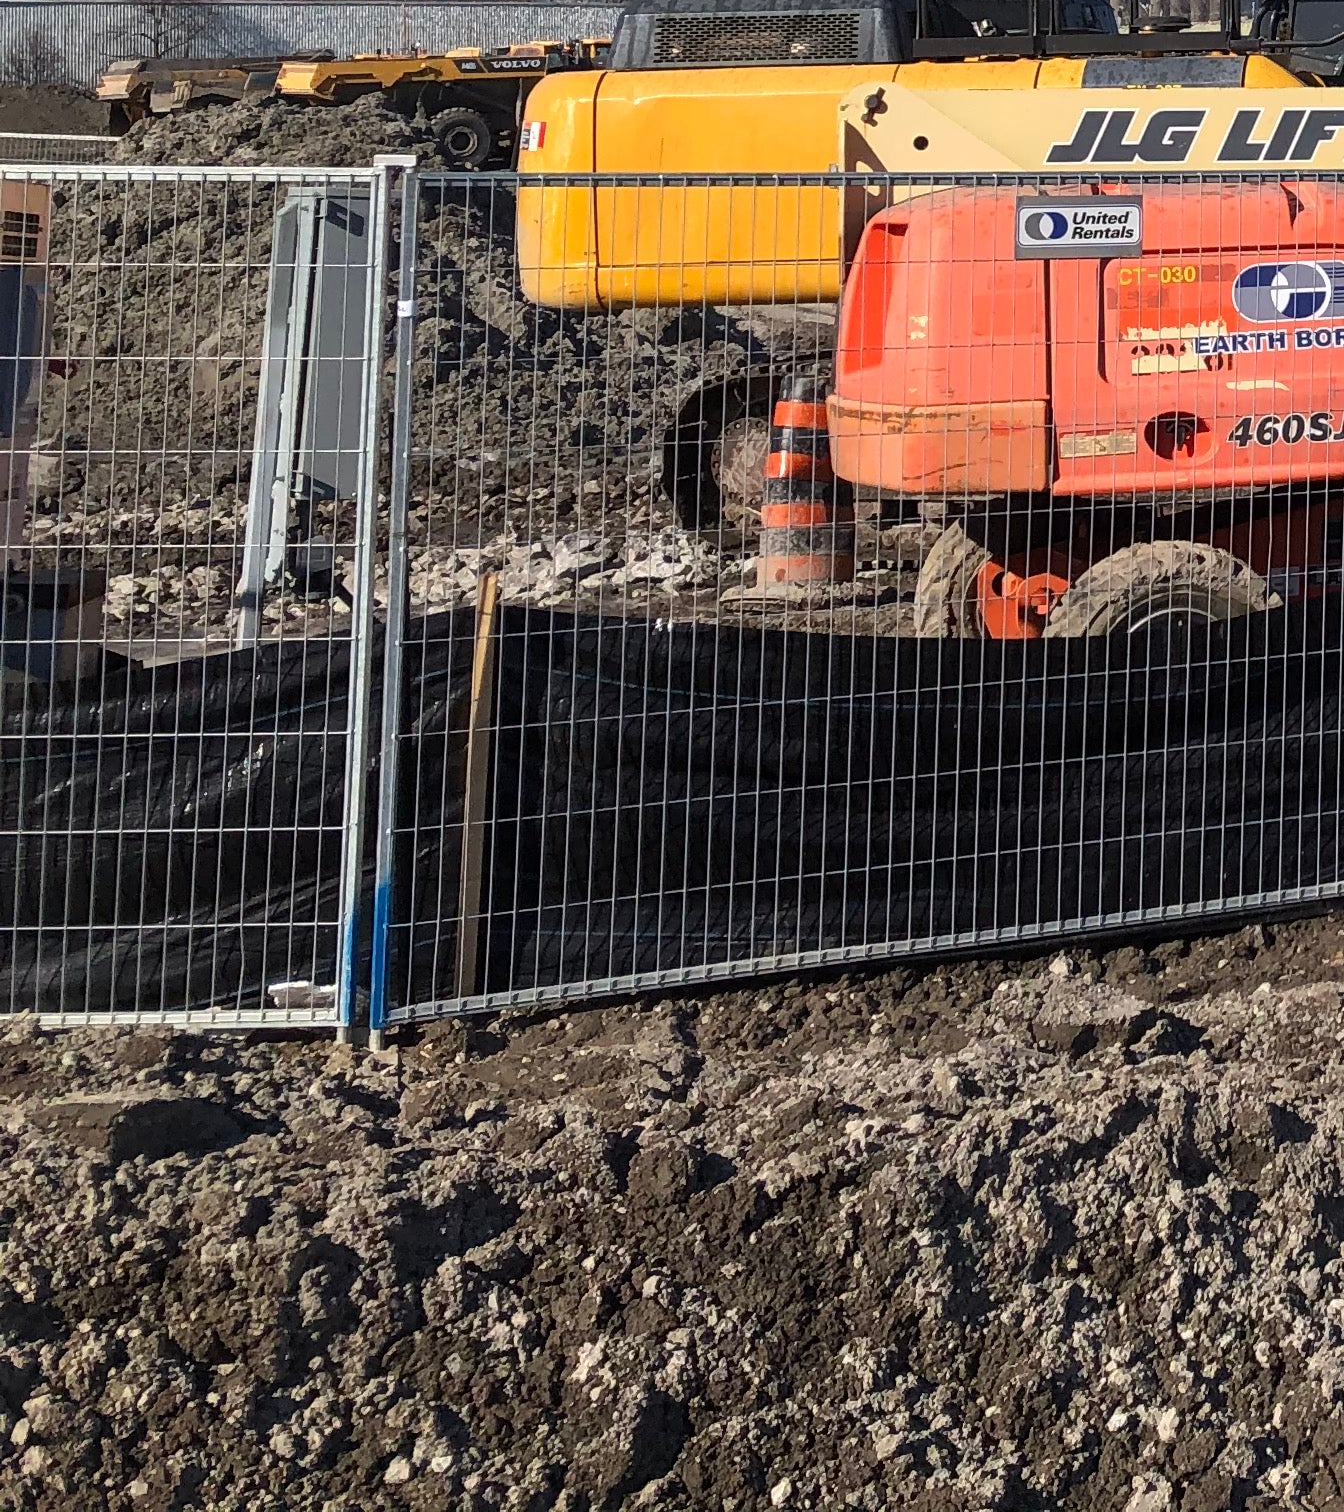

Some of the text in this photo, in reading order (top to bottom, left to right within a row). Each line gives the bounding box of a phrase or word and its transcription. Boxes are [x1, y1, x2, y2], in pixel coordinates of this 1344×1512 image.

[490, 59, 541, 69] VOLVO
[1044, 109, 1208, 164] JLG
[1072, 211, 1130, 226] United
[1072, 226, 1134, 240] Rentals
[1118, 265, 1197, 286] CT-030
[1193, 332, 1287, 355] EARTH
